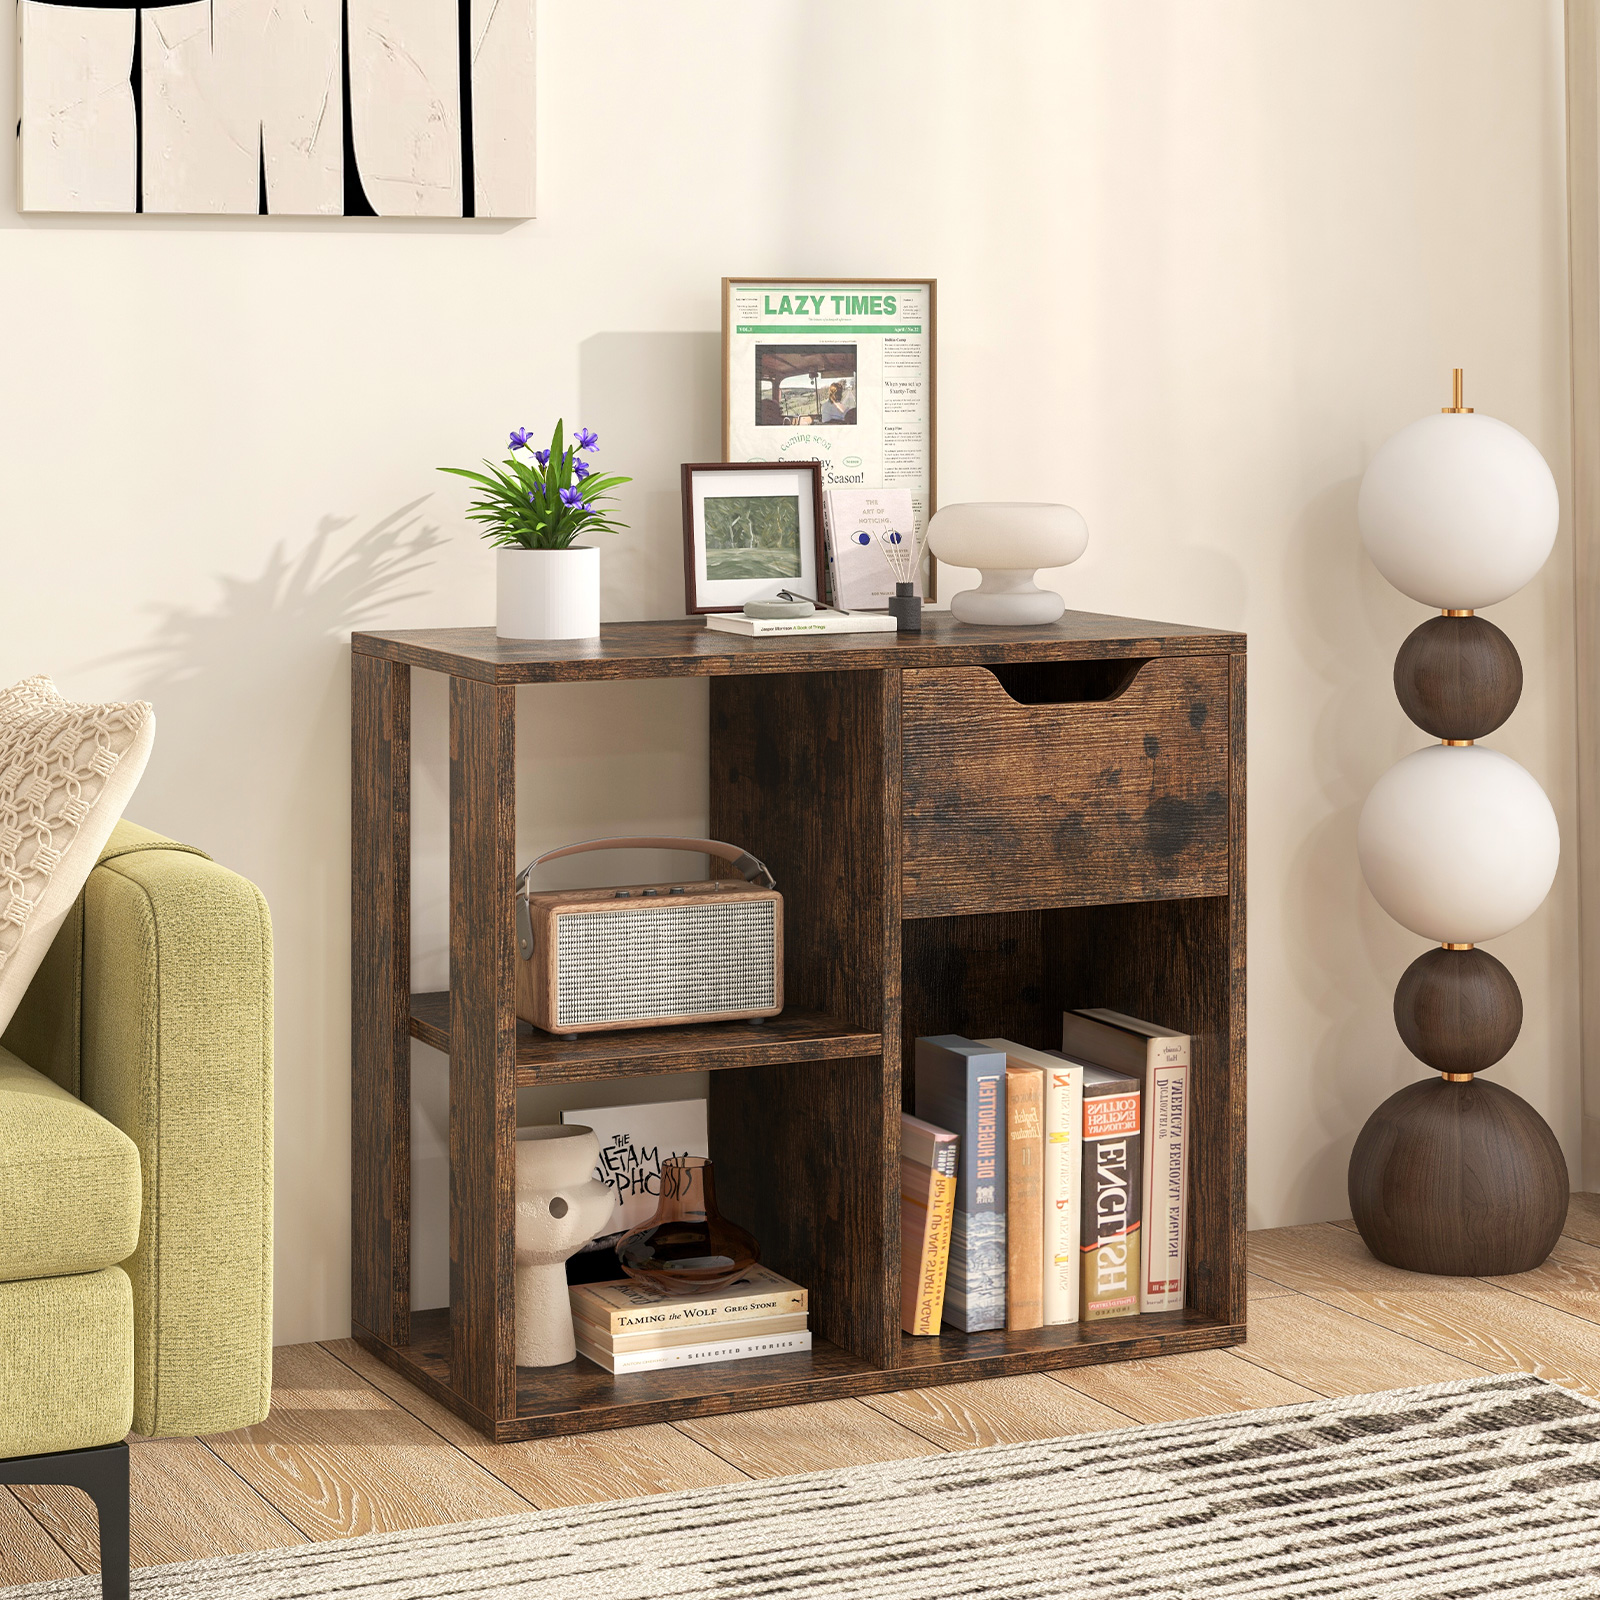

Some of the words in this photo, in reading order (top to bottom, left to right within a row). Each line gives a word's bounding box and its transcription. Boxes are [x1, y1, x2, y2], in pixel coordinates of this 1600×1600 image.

[764, 295, 825, 315] LAZY
[830, 295, 897, 315] TIMES
[780, 432, 811, 452] coming
[813, 435, 833, 451] soon
[827, 472, 864, 484] Season!
[611, 1133, 630, 1148] THE
[617, 1314, 666, 1327] TAMING
[668, 1312, 682, 1321] the
[683, 1307, 718, 1318] WOLF
[724, 1305, 748, 1313] GREG
[750, 1301, 777, 1311] STONE
[687, 1347, 740, 1360] SELECTED
[747, 1341, 794, 1352] STORIES
